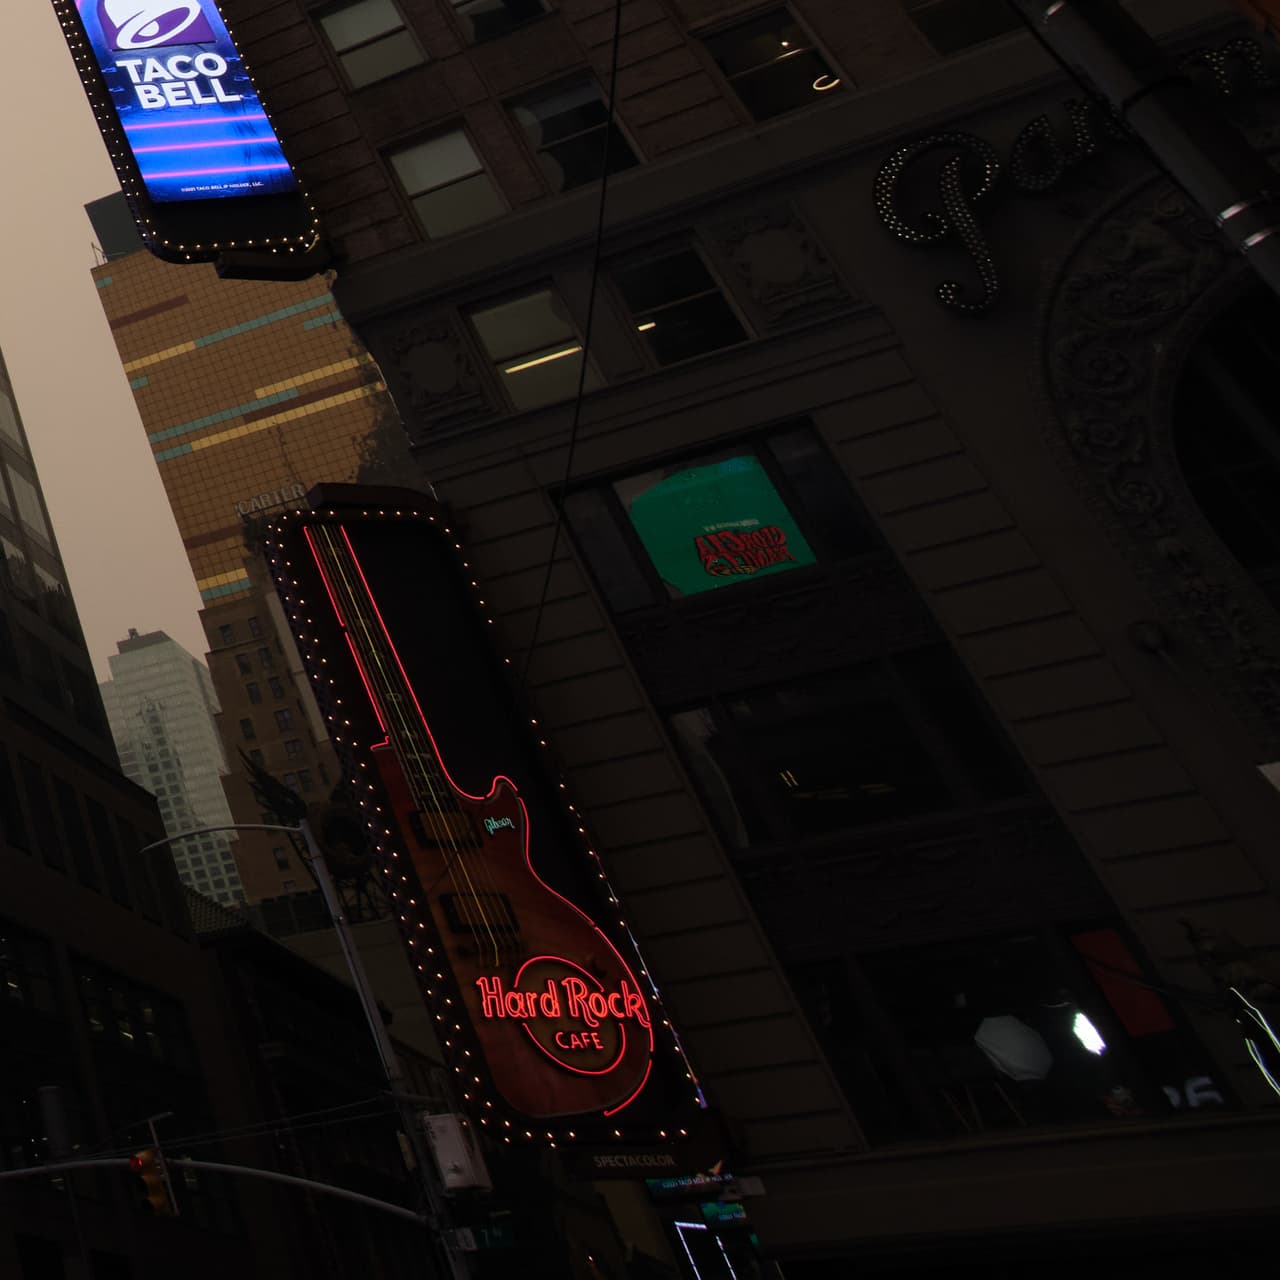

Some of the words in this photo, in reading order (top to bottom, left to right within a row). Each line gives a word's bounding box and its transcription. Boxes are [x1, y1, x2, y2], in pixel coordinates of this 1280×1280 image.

[115, 52, 228, 83] TACO
[134, 78, 241, 110] BELL
[475, 976, 561, 1019] Hard
[561, 976, 652, 1029] Rock
[554, 1031, 605, 1051] CAFE
[592, 1152, 677, 1169] SPECTACOLOR
